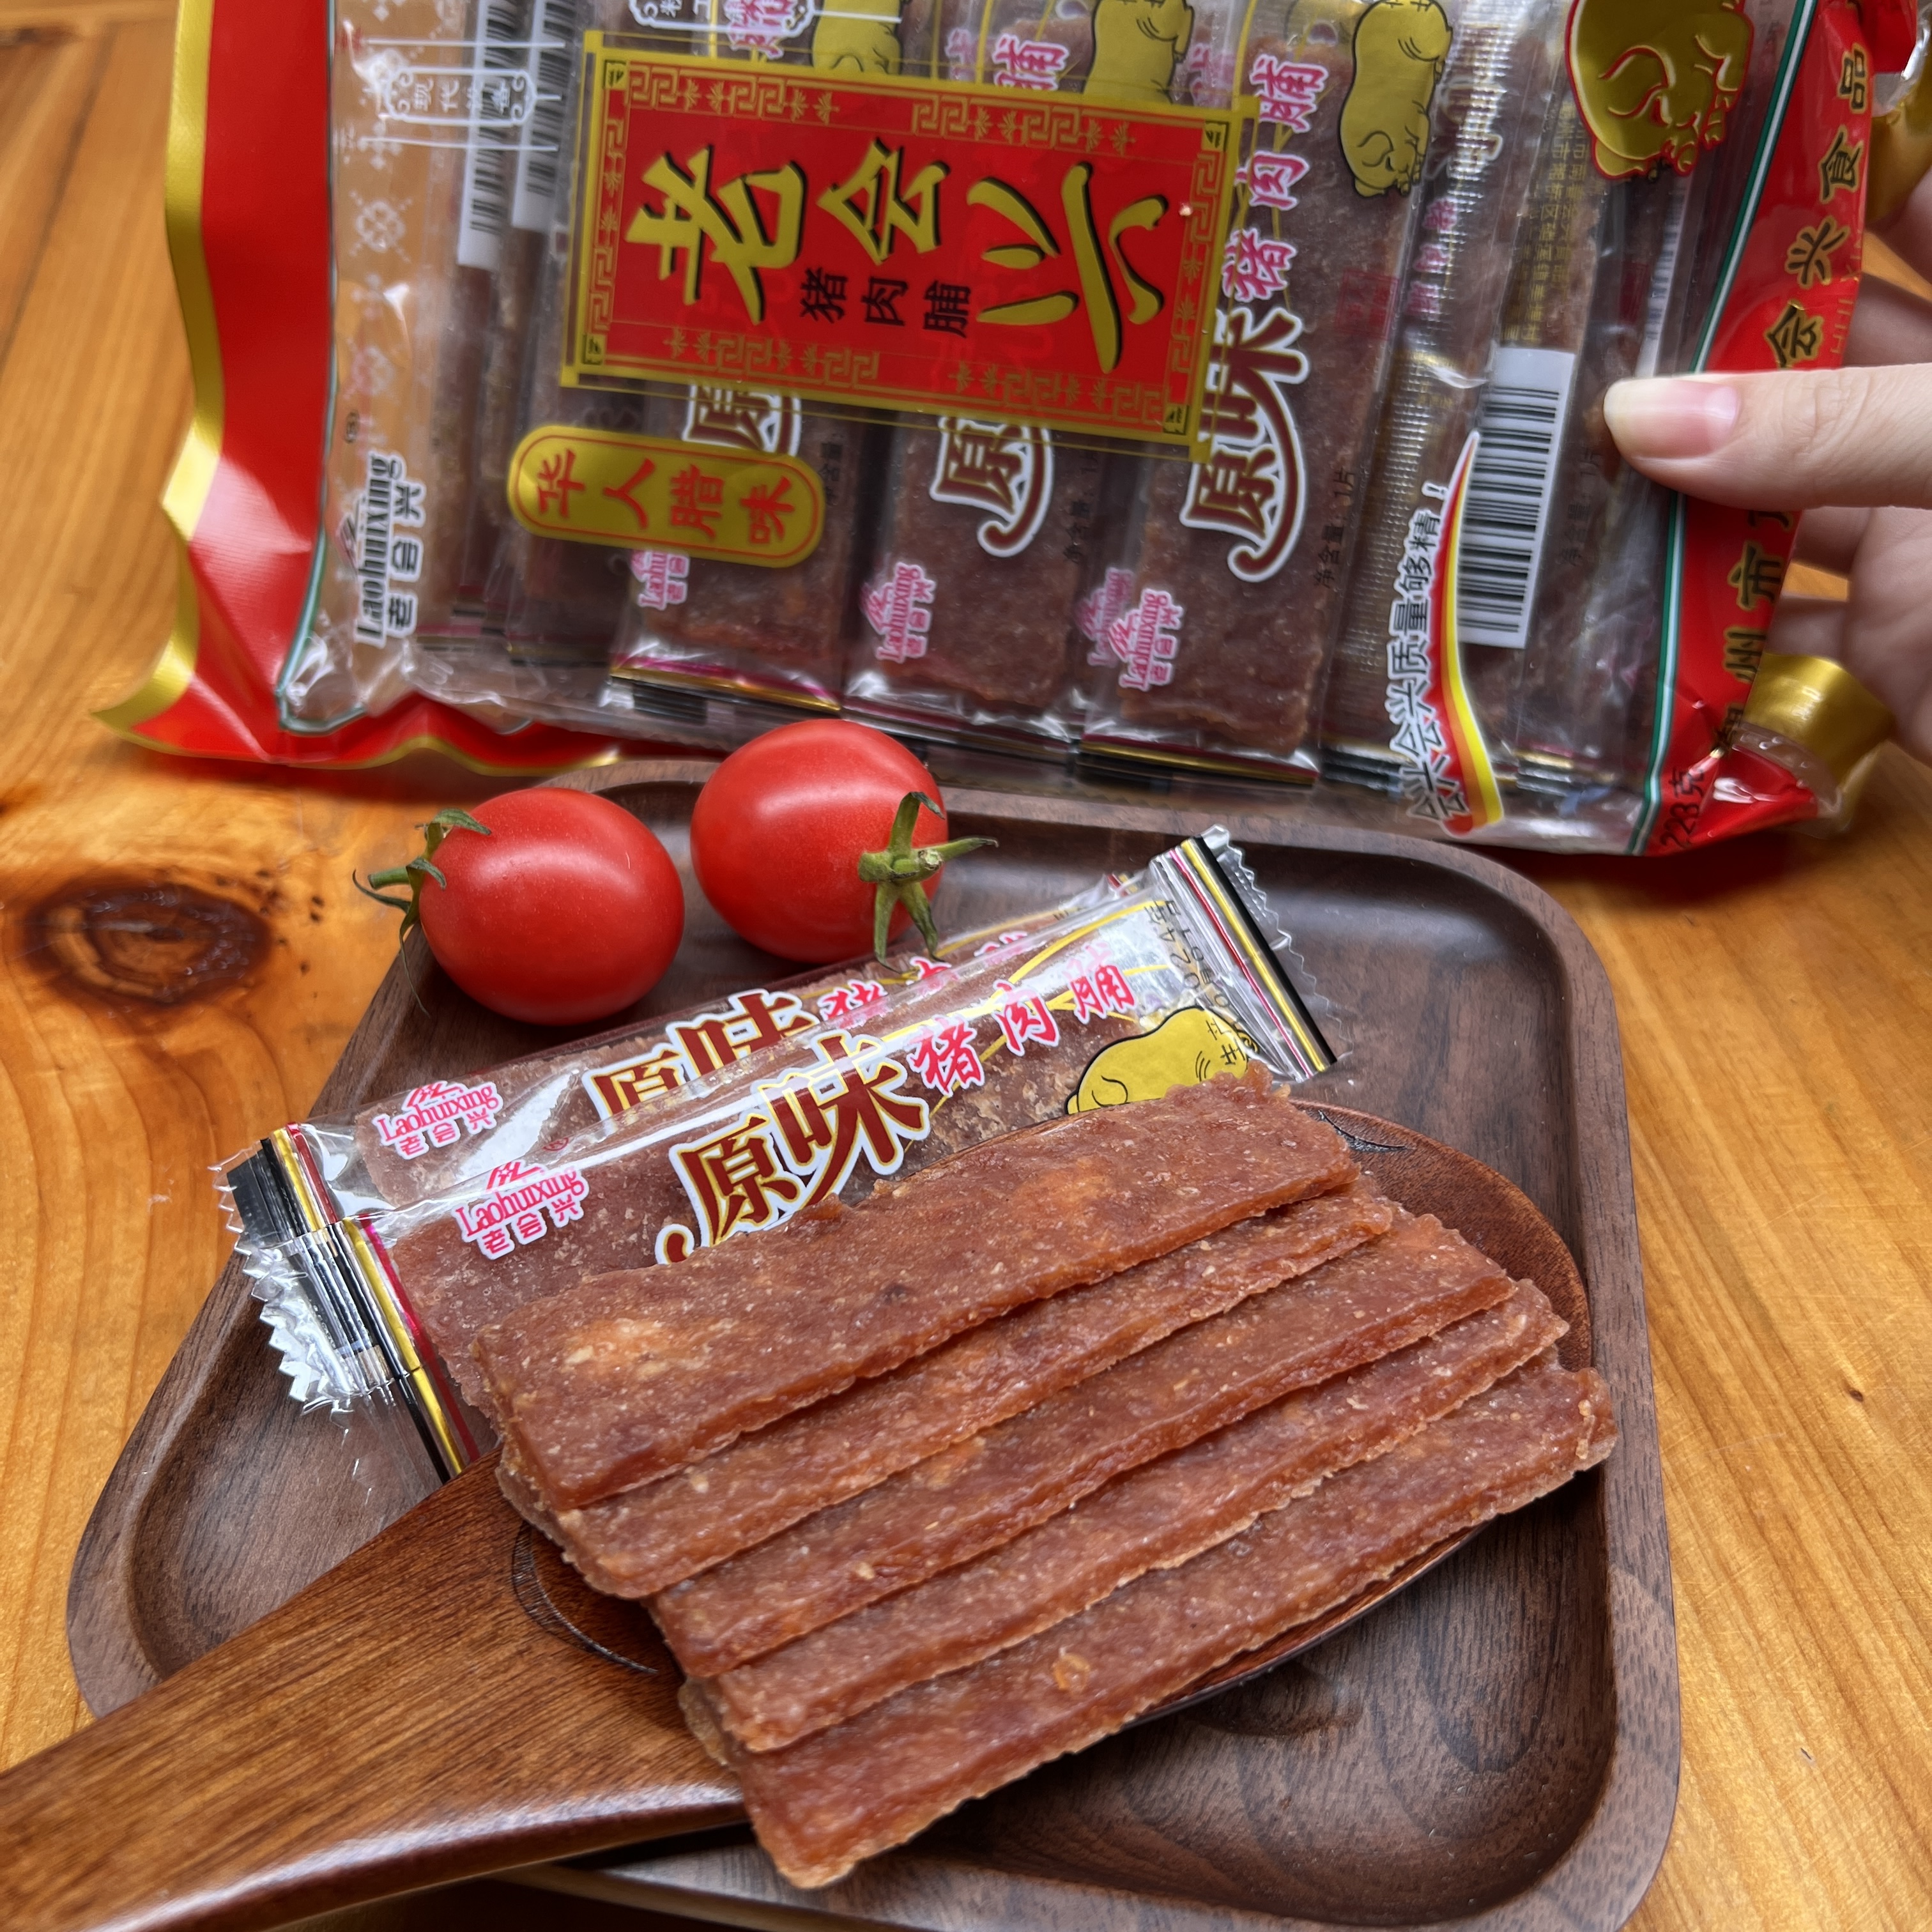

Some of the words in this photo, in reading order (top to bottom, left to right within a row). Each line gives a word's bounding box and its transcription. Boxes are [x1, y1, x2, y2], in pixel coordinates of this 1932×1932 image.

[1223, 56, 1327, 299] 猪肉脯
[625, 137, 1169, 374] 老会兴
[800, 267, 972, 338] 猪肉脯
[537, 450, 796, 546] 华人腊味
[358, 452, 402, 646] Laohuixing
[388, 482, 421, 631] 老会兴
[907, 579, 935, 656] 老会兴
[1151, 605, 1183, 682] 老会兴
[908, 942, 1136, 1094] 猪肉脯
[377, 1084, 500, 1142] Laohuixing
[399, 1108, 493, 1156] 老会兴
[675, 1034, 925, 1246] 原味
[456, 1169, 585, 1238] Laohuixing
[482, 1195, 578, 1254] 老会兴
